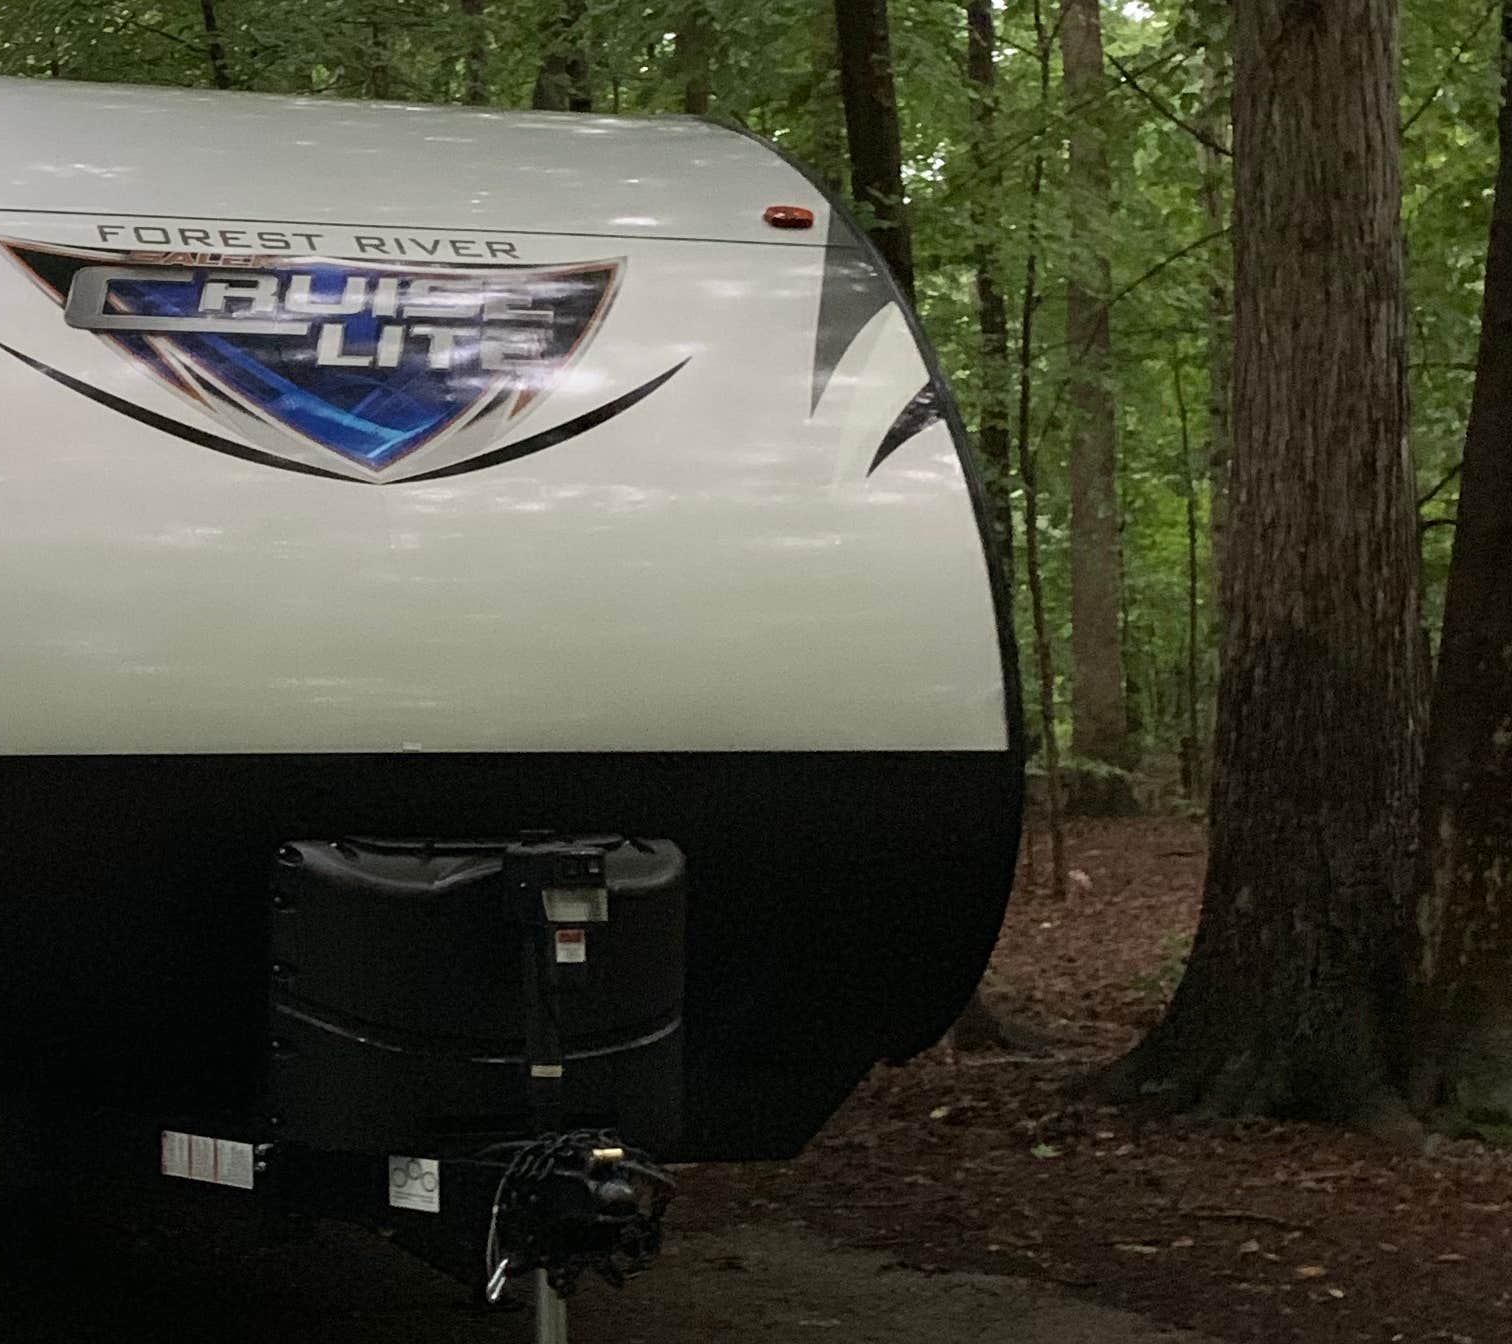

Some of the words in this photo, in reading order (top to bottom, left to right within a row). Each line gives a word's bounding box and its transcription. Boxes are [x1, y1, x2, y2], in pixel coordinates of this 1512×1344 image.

[97, 225, 324, 251] FOREST
[354, 236, 520, 258] RIVER
[65, 265, 554, 335] CRUISE
[316, 323, 555, 370] LITE
